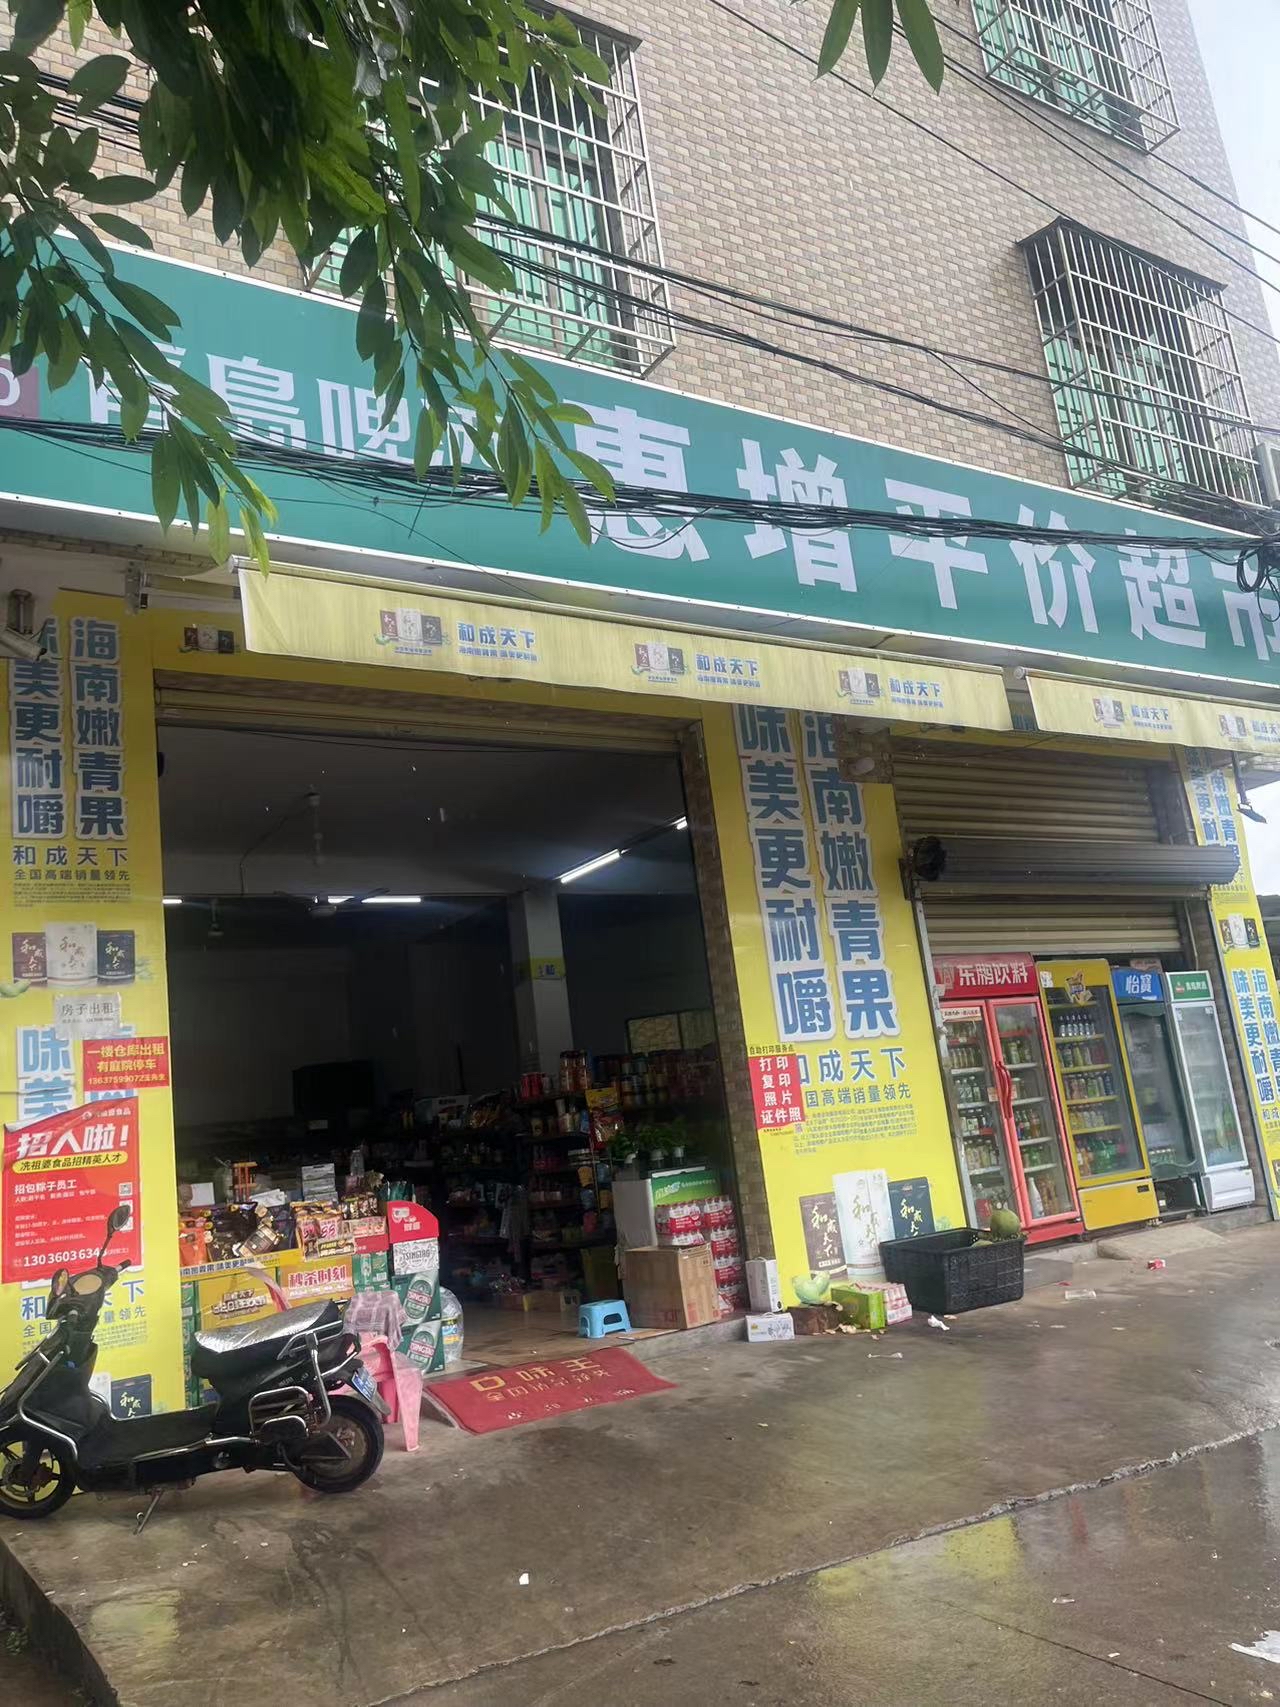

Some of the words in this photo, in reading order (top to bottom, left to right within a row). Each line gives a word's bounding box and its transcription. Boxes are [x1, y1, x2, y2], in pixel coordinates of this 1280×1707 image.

[564, 398, 1280, 662] 惠增平价超市
[457, 622, 536, 649] 和成天下
[695, 652, 758, 676] 和成天下
[889, 677, 941, 698] 和成天下
[73, 618, 125, 836] 海南嫩青果
[13, 846, 128, 867] 和成天下
[15, 868, 130, 881] 全国高端销量领先
[734, 703, 833, 1036] 味美更耐嚼
[956, 961, 1029, 987] 东鹏饮料
[61, 1002, 114, 1016] 房子出租
[87, 1043, 165, 1058] 一楼仓库出租
[97, 1059, 156, 1073] 有庭院停车
[759, 1056, 789, 1072] 打印
[762, 1073, 791, 1089] 复印
[764, 1091, 792, 1107] 照片
[761, 1107, 802, 1125] 证件照
[14, 1179, 77, 1195] 招包粽子员工
[23, 1255, 46, 1267] 130
[47, 1250, 77, 1264] 3603
[288, 1265, 346, 1289] 秒杀时刻
[469, 1357, 600, 1392] 口味王
